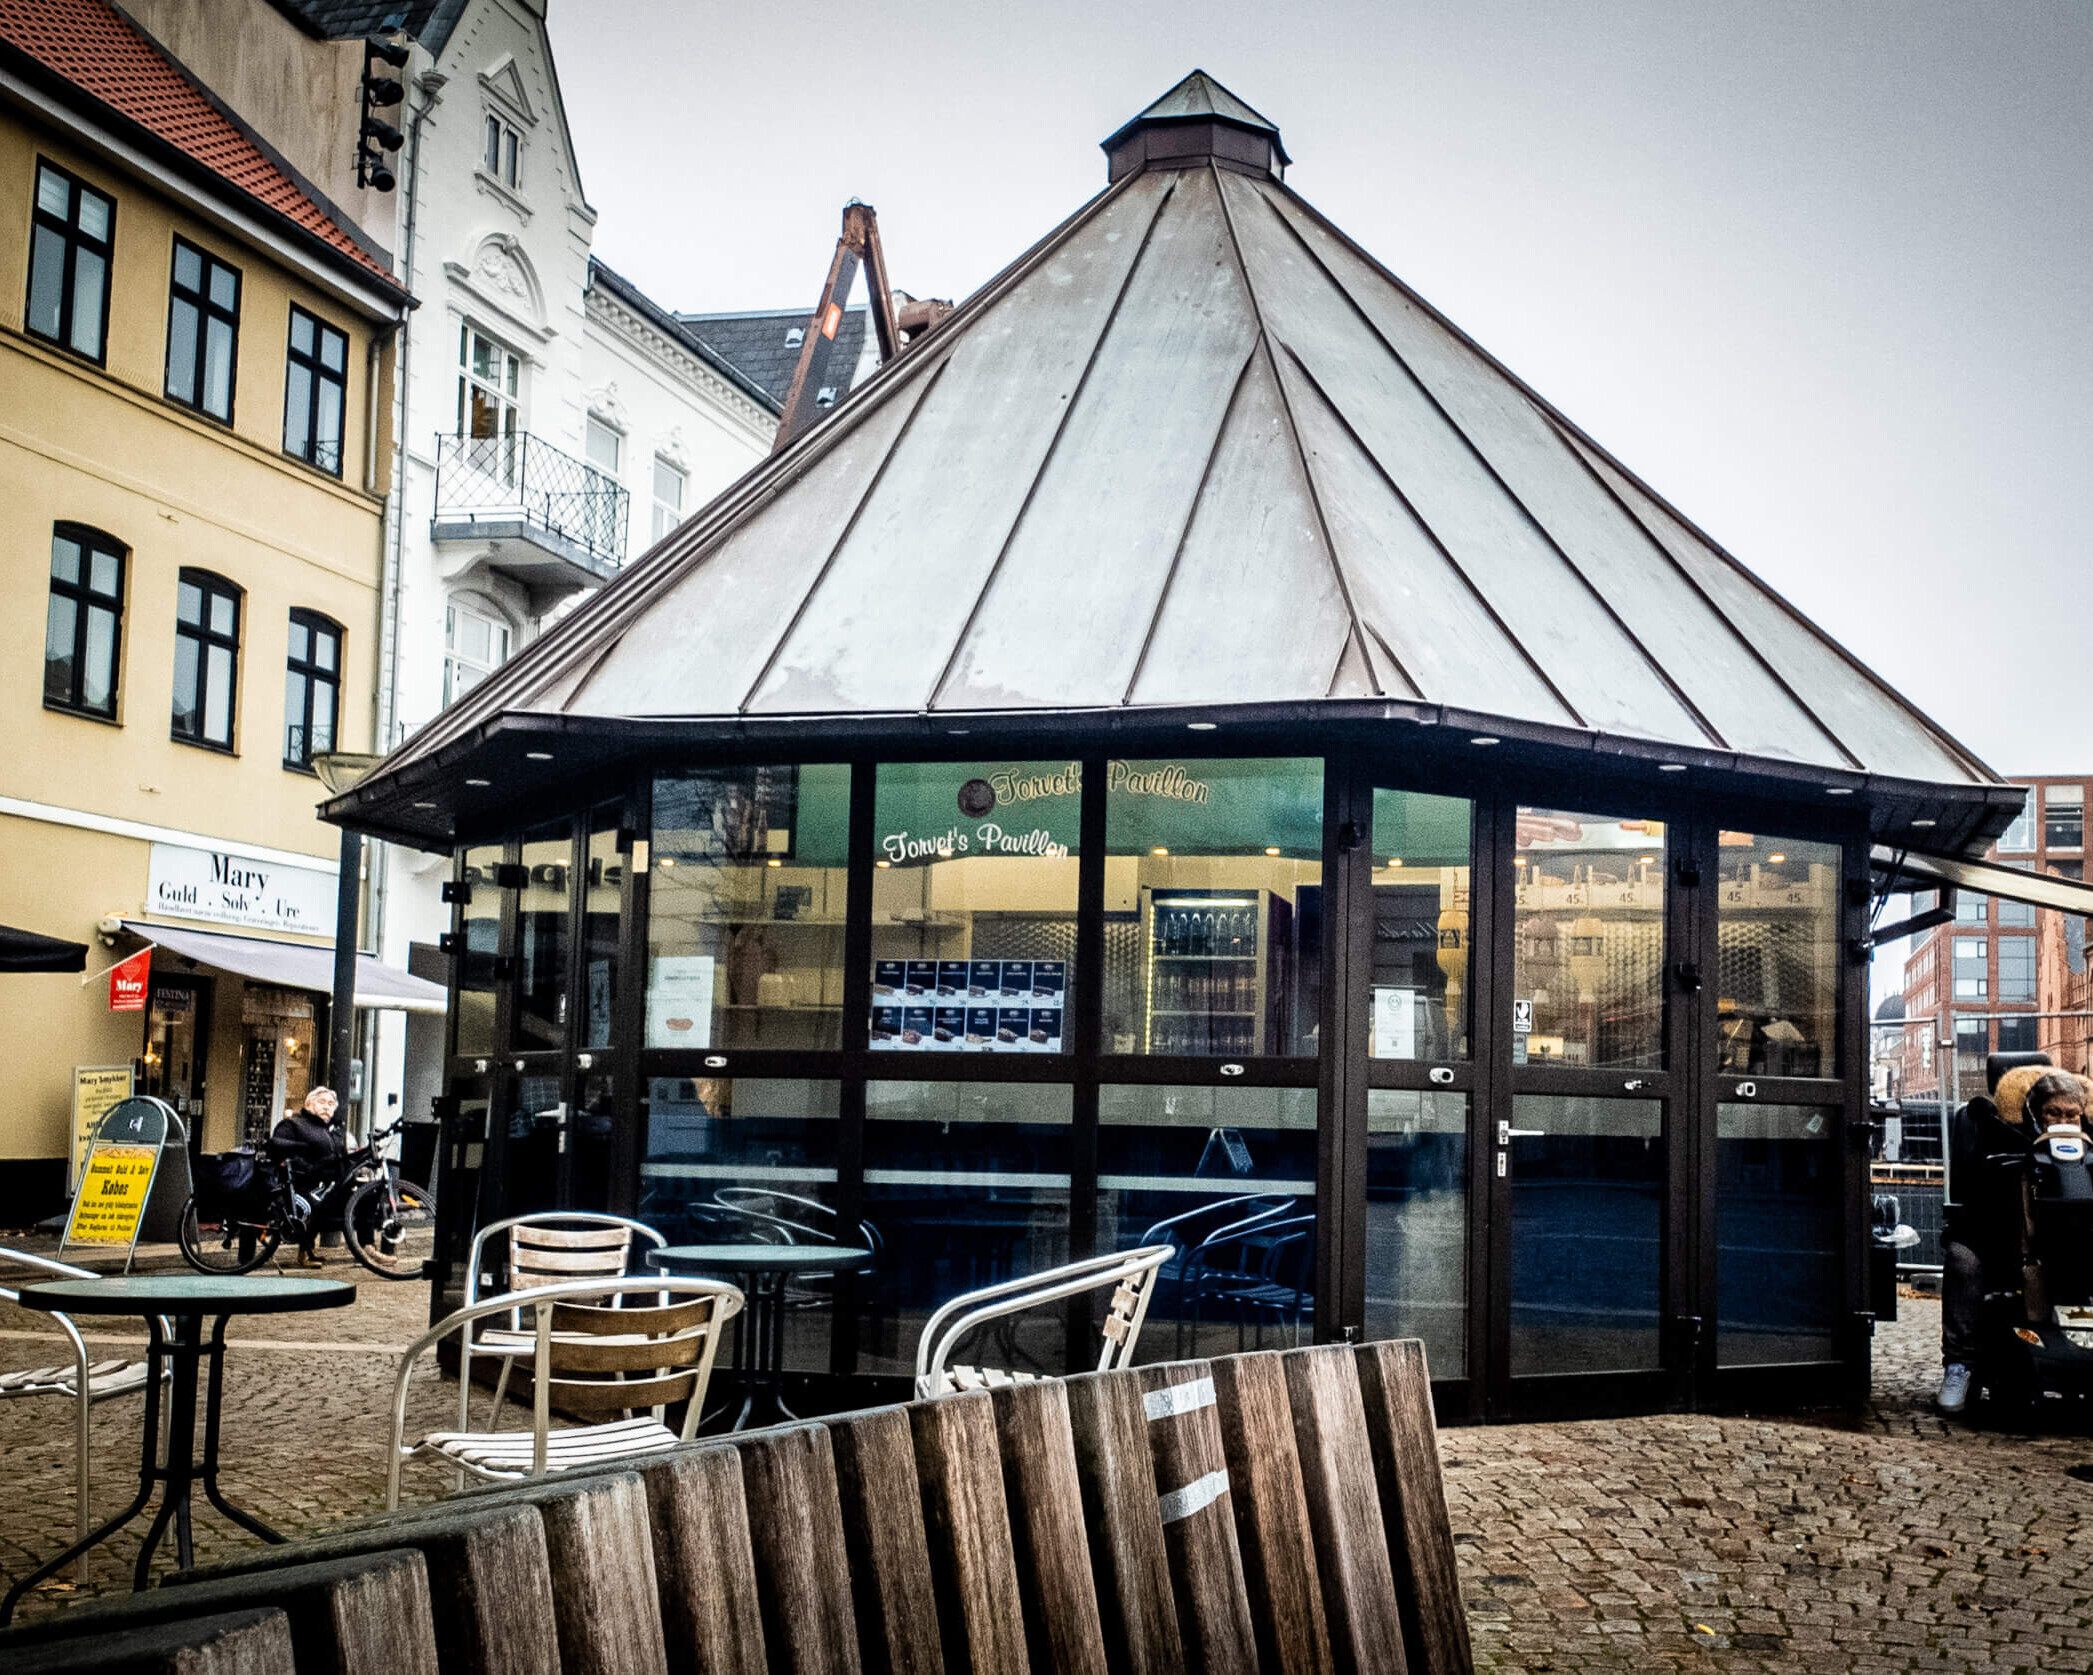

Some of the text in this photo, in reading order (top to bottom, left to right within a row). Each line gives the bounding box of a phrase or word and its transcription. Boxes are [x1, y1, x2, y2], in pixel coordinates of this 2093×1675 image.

[1107, 759, 1209, 804] Pavillon
[883, 823, 1068, 863] Torvet's Pavillon
[209, 853, 270, 901] Mary
[159, 880, 197, 905] Guld
[276, 898, 300, 918] Ure
[116, 980, 143, 992] Mary
